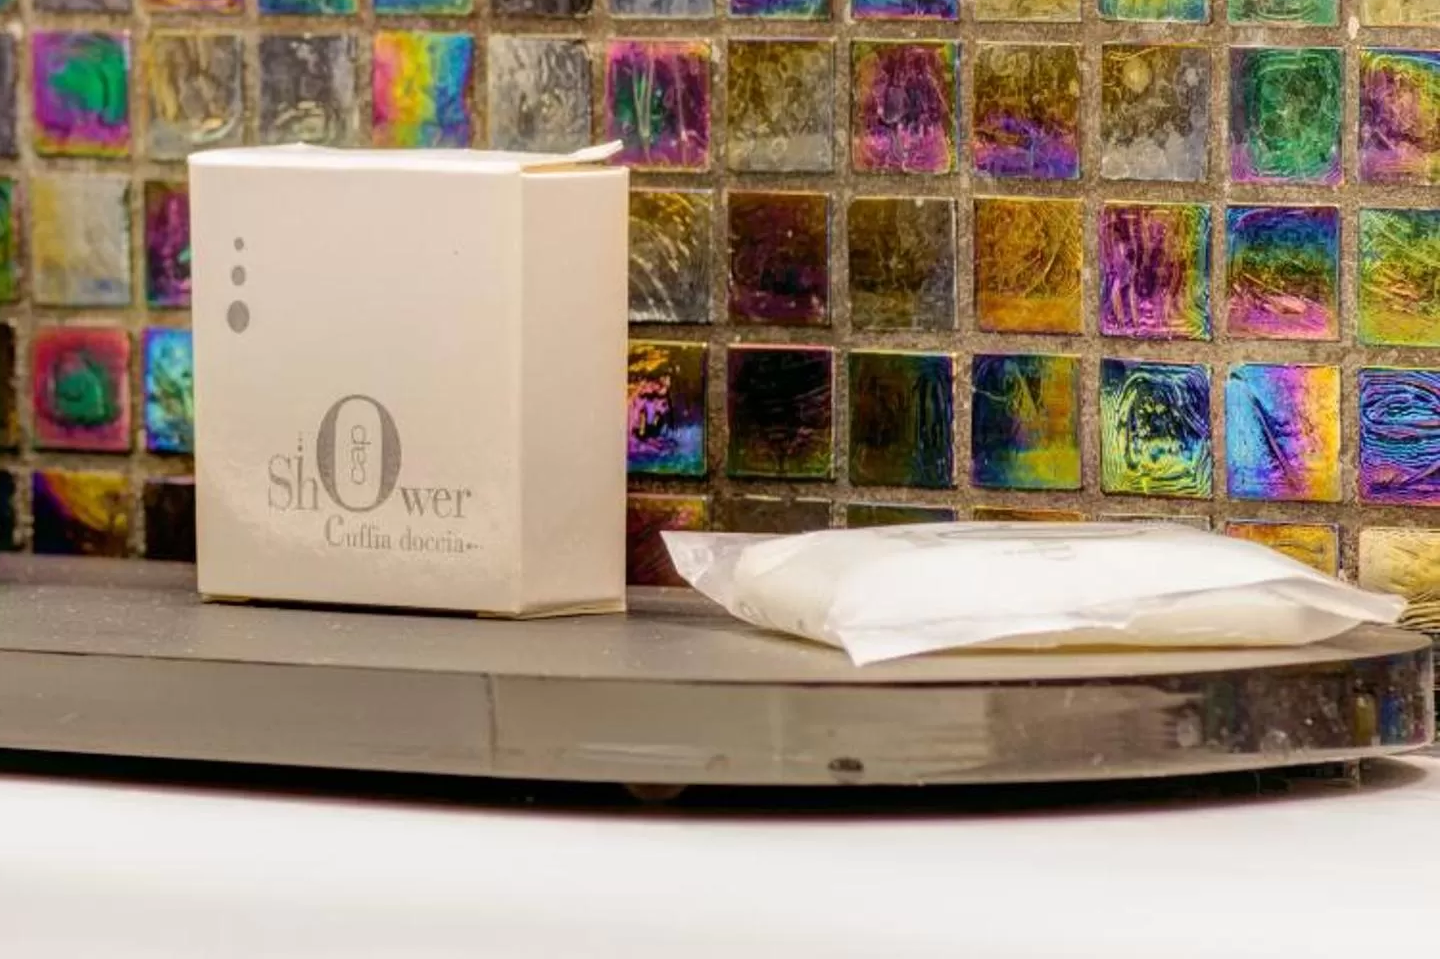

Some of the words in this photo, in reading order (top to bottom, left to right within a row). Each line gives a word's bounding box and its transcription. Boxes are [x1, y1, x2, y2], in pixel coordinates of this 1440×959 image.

[349, 424, 372, 485] cap
[323, 513, 392, 550] Cuffia
[399, 527, 464, 554] doccia
